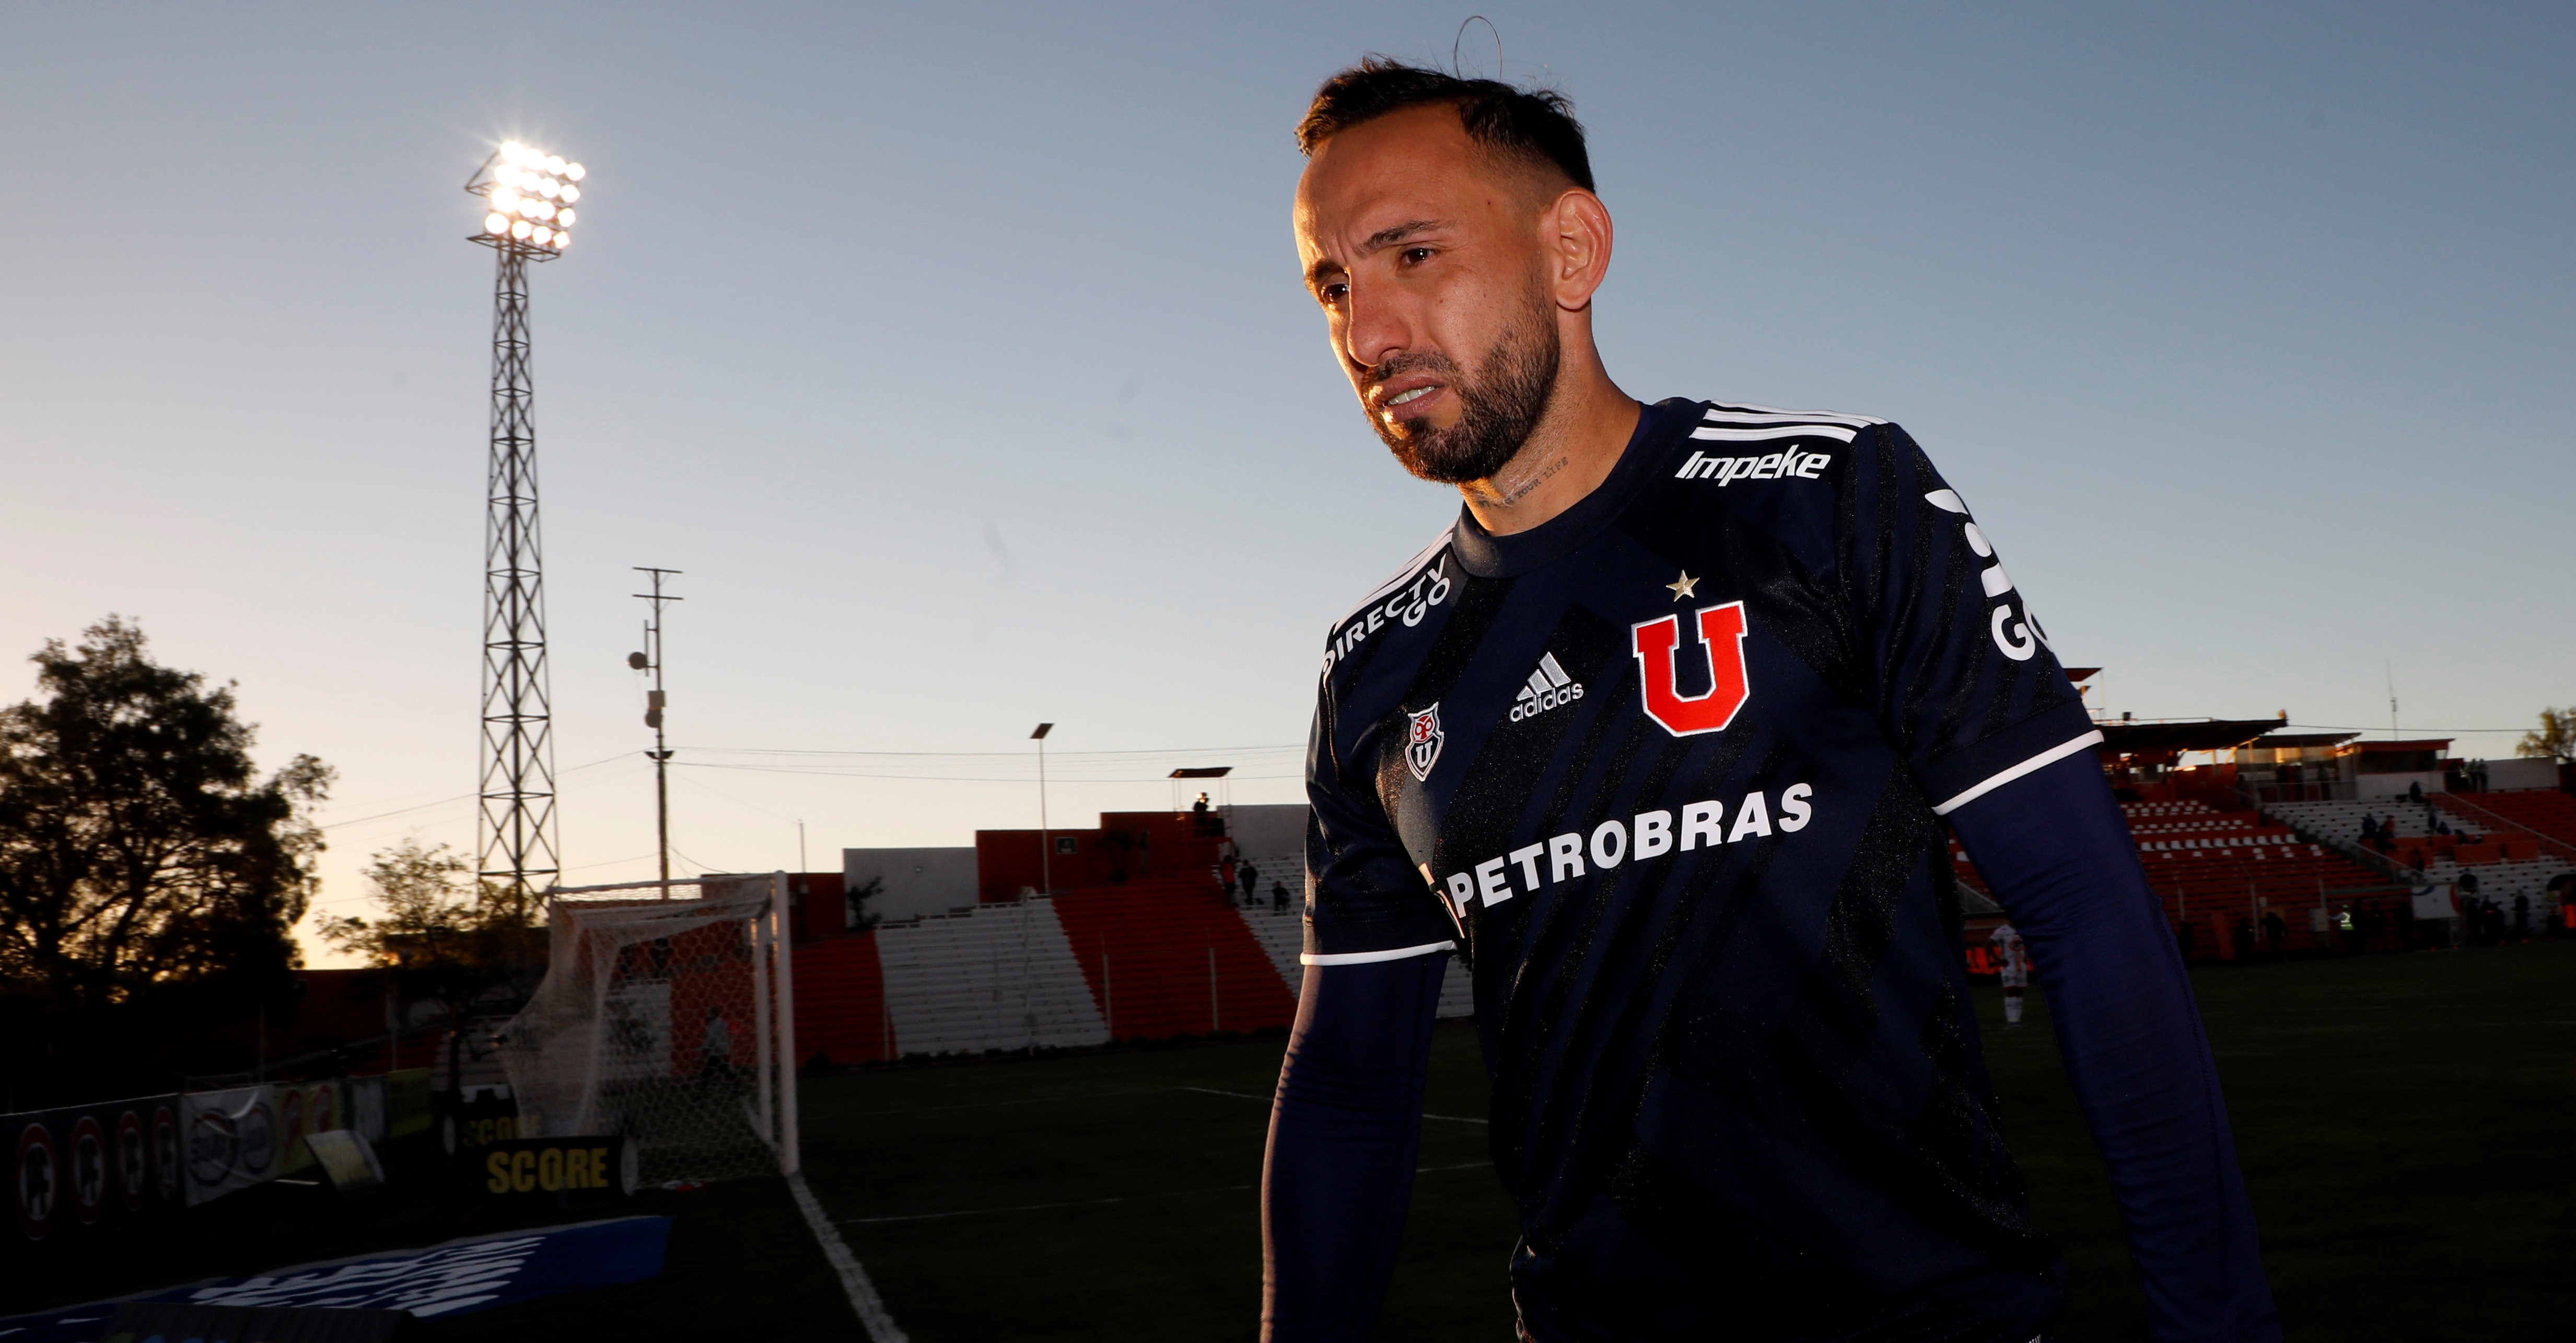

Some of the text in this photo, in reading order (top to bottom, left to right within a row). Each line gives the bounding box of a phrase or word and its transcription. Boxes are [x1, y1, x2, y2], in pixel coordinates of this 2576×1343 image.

[1542, 457, 1569, 479] LIFE
[1674, 444, 1832, 487] Impeke
[1322, 552, 1447, 685] DIRECTV
[1402, 577, 1451, 628] GO
[1631, 600, 1750, 738] U
[1509, 682, 1584, 723] adidas
[1415, 739, 1433, 768] U
[1446, 782, 1814, 919] PETROBRAS
[461, 1115, 541, 1148] SCO
[485, 1147, 610, 1195] SCORE
